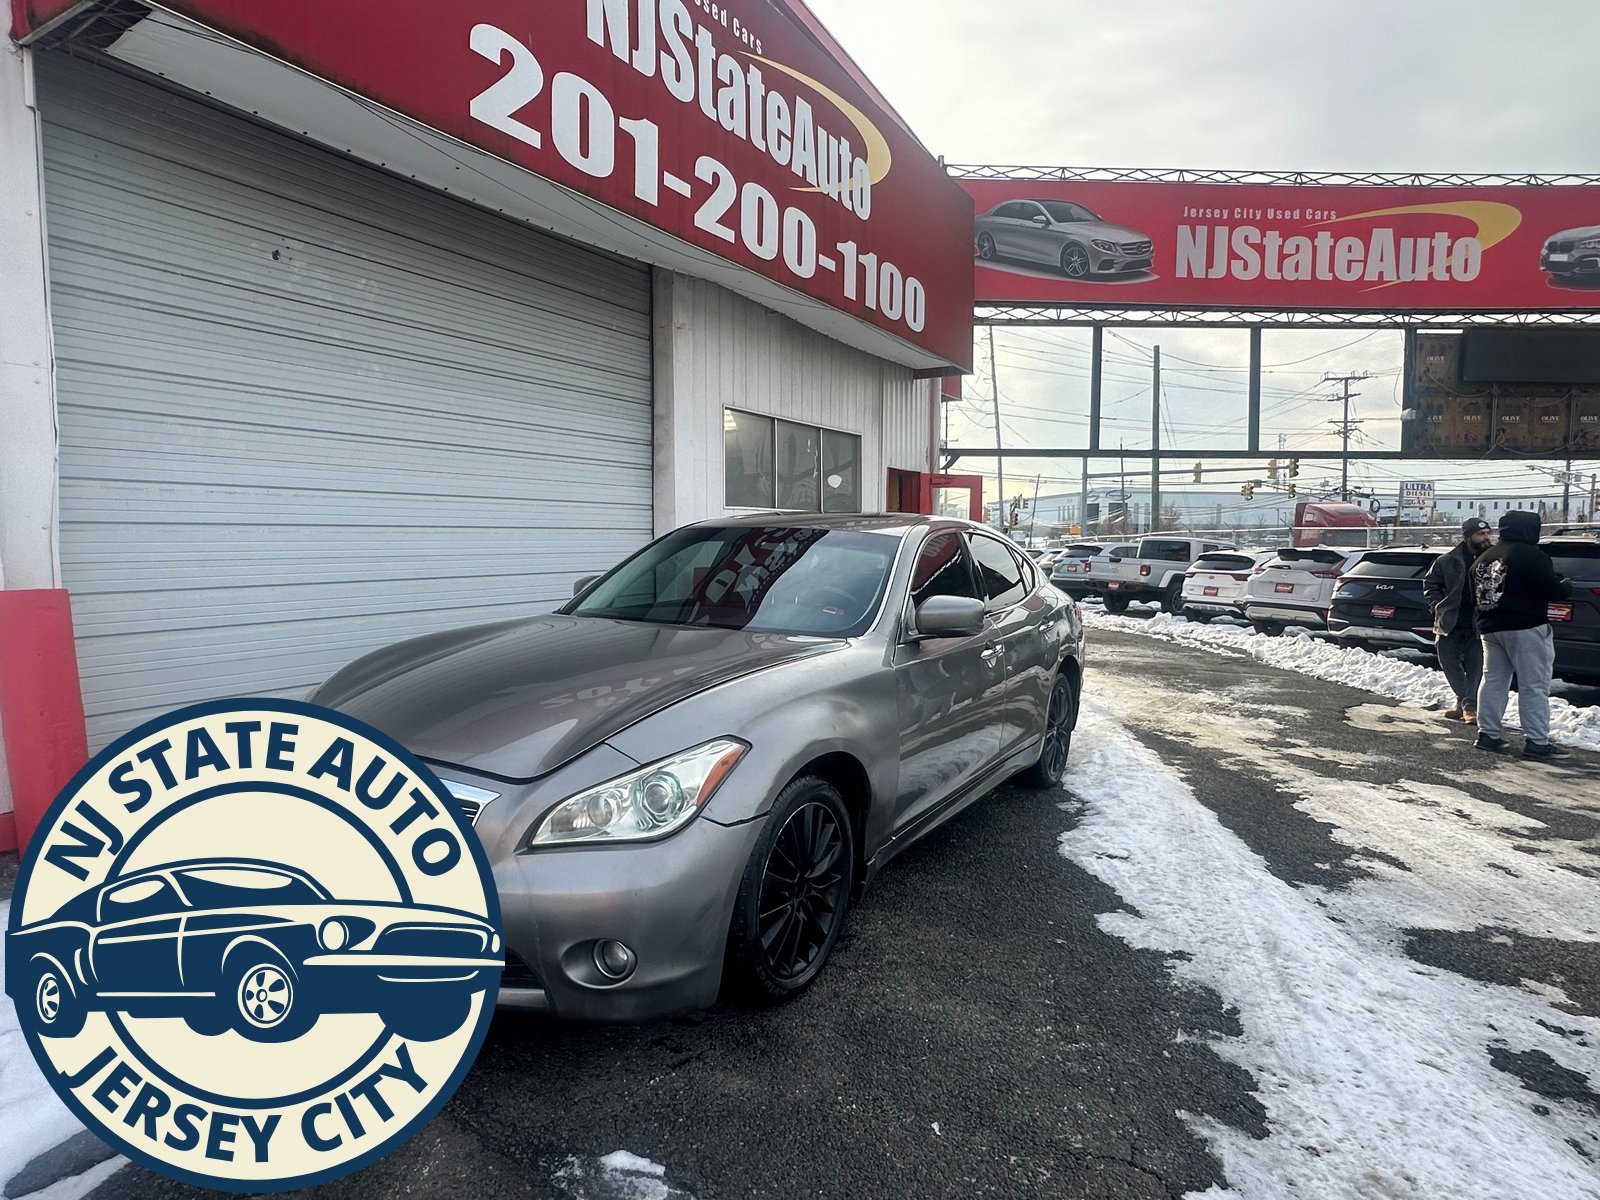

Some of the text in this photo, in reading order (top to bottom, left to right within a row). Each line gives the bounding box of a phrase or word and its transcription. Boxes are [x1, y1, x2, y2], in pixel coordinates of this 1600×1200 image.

[733, 17, 762, 55] Cars
[469, 23, 925, 332] 201-200-1100
[1183, 206, 1337, 220] Jersey City Used Cars
[1175, 225, 1482, 282] NJStateAuto
[1405, 483, 1432, 491] ULTRA
